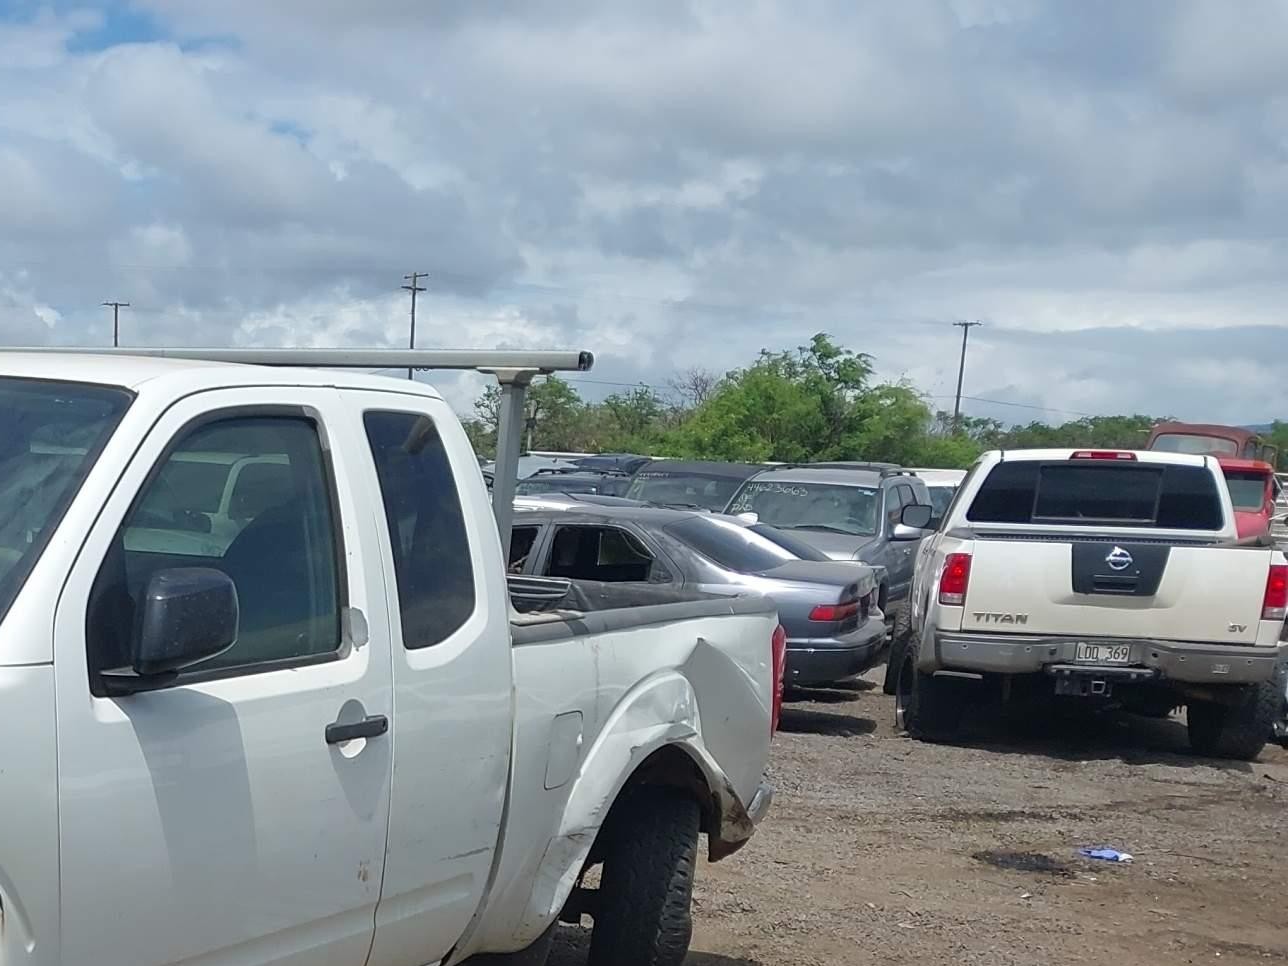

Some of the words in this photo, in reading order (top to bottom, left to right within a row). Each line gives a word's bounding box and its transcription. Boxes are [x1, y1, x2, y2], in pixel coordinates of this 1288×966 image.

[973, 612, 1028, 624] TITAN
[1228, 624, 1248, 633] SV
[1105, 646, 1128, 660] 369
